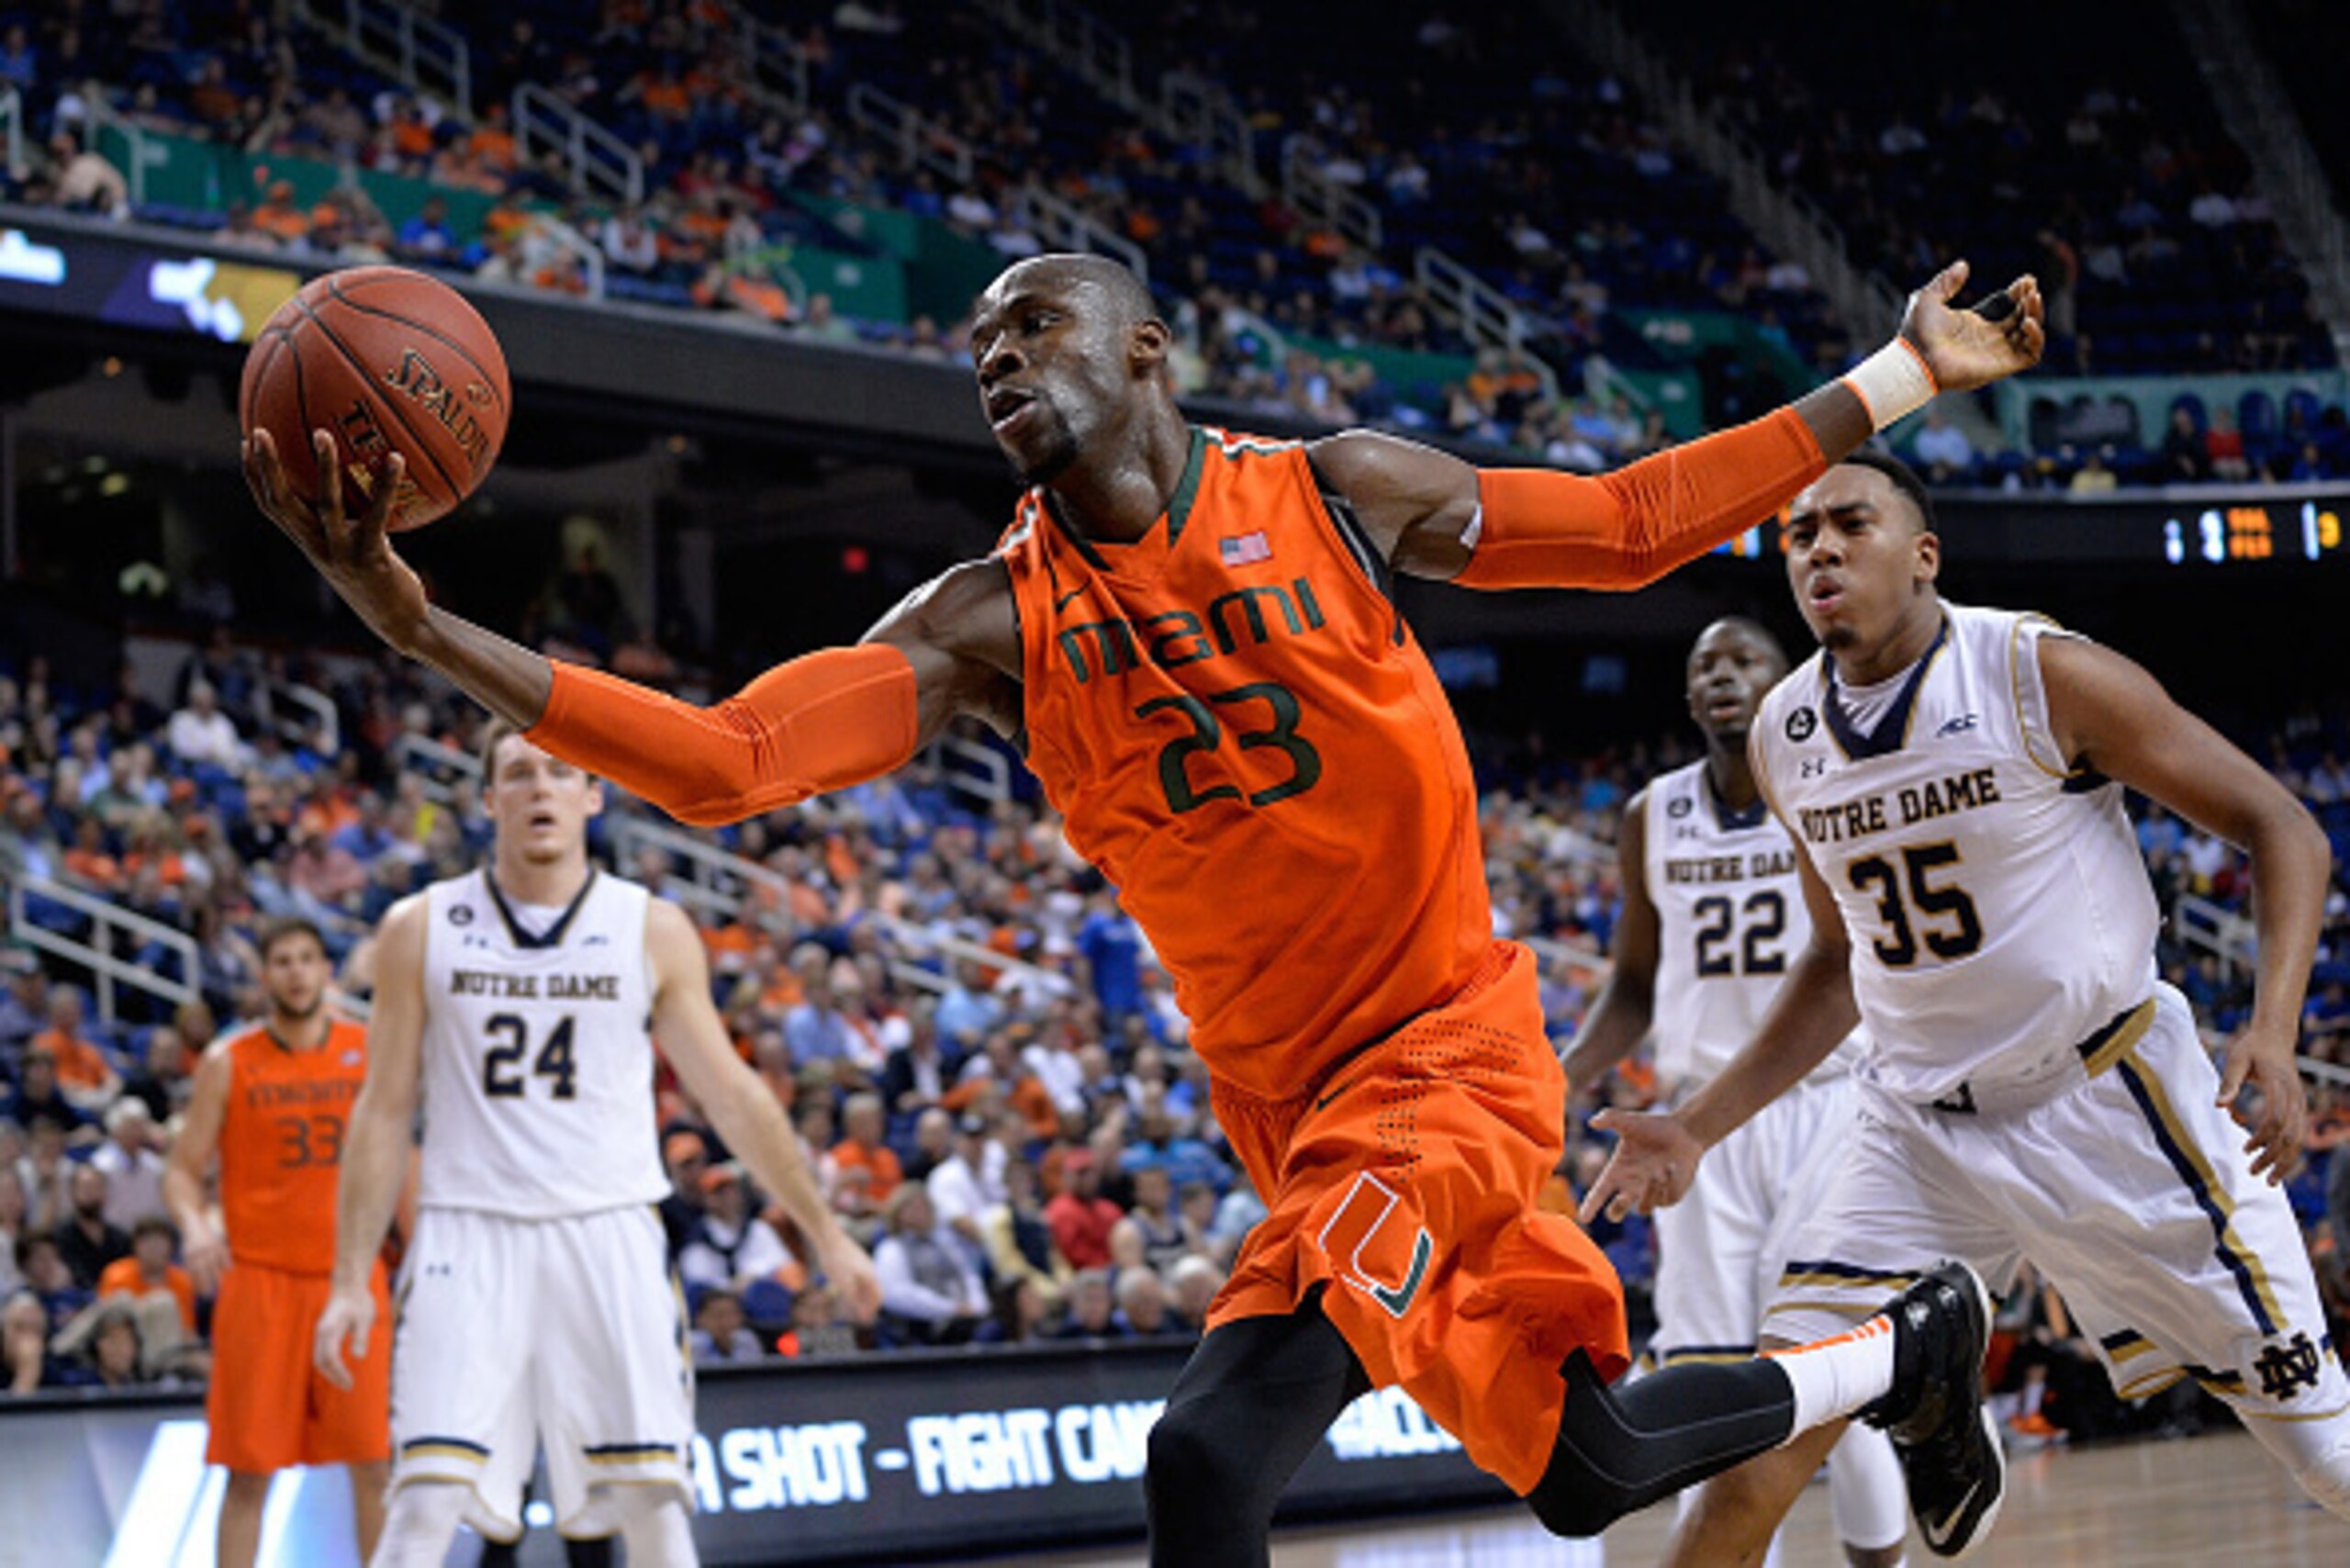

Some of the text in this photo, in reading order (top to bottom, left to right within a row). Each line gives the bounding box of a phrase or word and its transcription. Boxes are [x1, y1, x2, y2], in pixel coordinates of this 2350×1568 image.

[1058, 577, 1326, 685] MAMI
[1135, 681, 1322, 814] 23
[1798, 767, 1999, 843] NOTRE DAME
[1665, 856, 1743, 884] NOTRE
[1845, 836, 1986, 969] 35
[1693, 889, 1785, 978] 22
[451, 969, 621, 1001] NOTRE DAME
[483, 1011, 578, 1100] 24
[274, 1114, 345, 1170] 33
[720, 1420, 869, 1512] SHOT
[907, 1407, 1055, 1496] FIGHT
[1056, 1396, 1168, 1482] CAN
